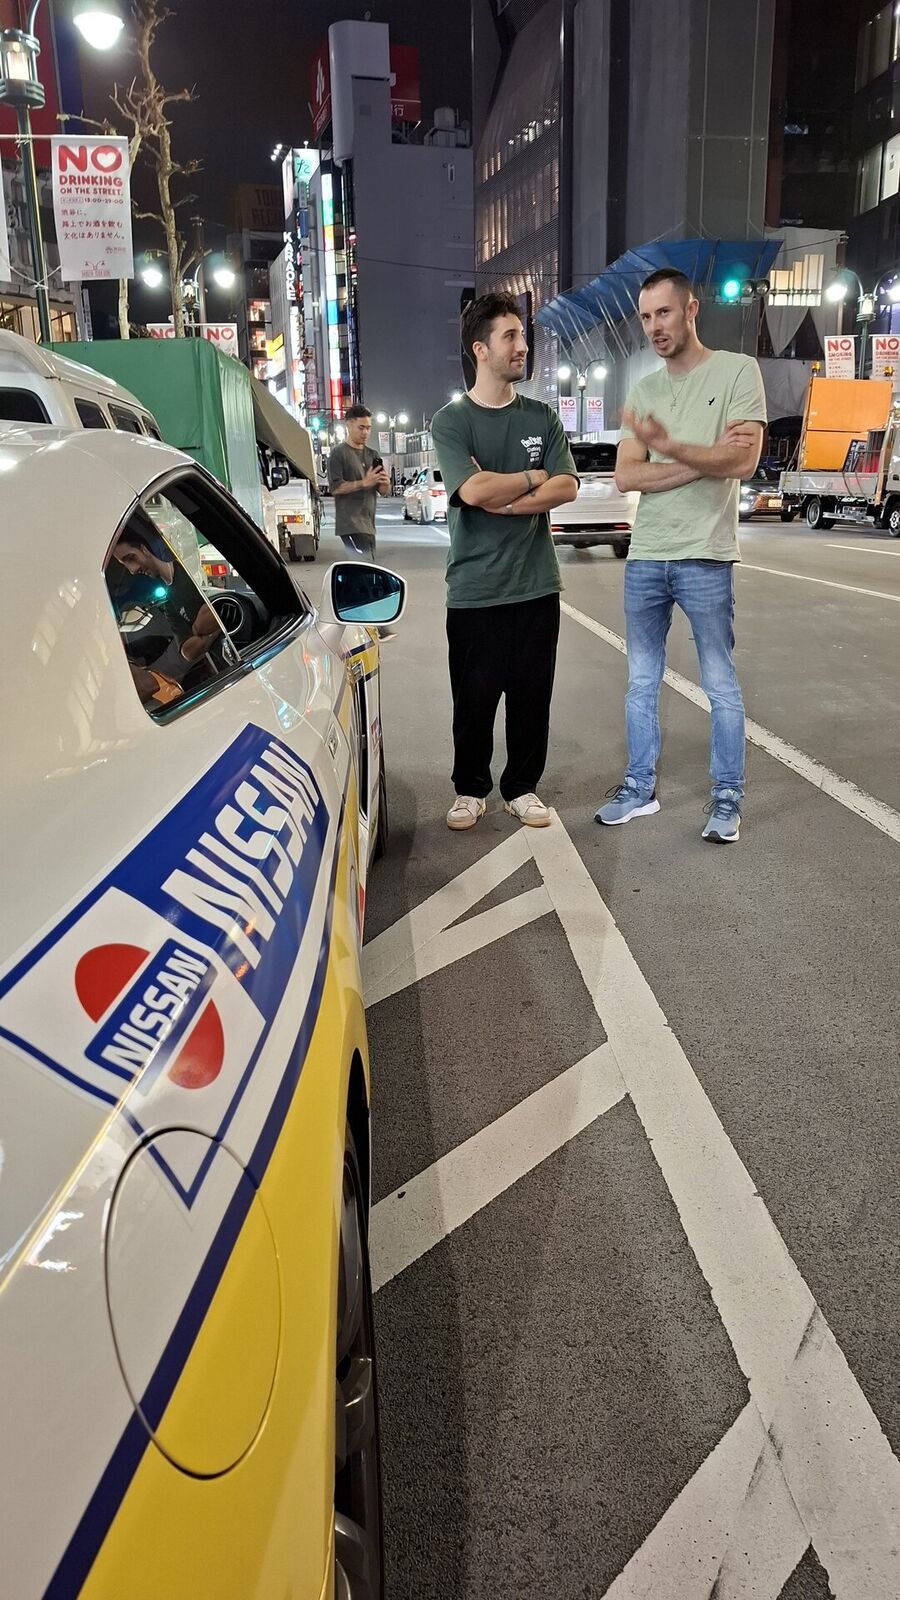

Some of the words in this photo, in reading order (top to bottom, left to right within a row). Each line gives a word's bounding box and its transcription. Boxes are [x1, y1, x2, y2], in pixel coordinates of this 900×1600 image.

[58, 145, 122, 173] NO
[59, 175, 123, 187] DRINKING
[64, 232, 125, 240] 文化はありません。
[283, 231, 297, 301] KARAOKE
[206, 328, 235, 341] NO
[827, 339, 852, 352] NO
[875, 338, 899, 351] NO
[160, 741, 319, 970] NISSAN
[101, 949, 210, 1074] NISSAN
